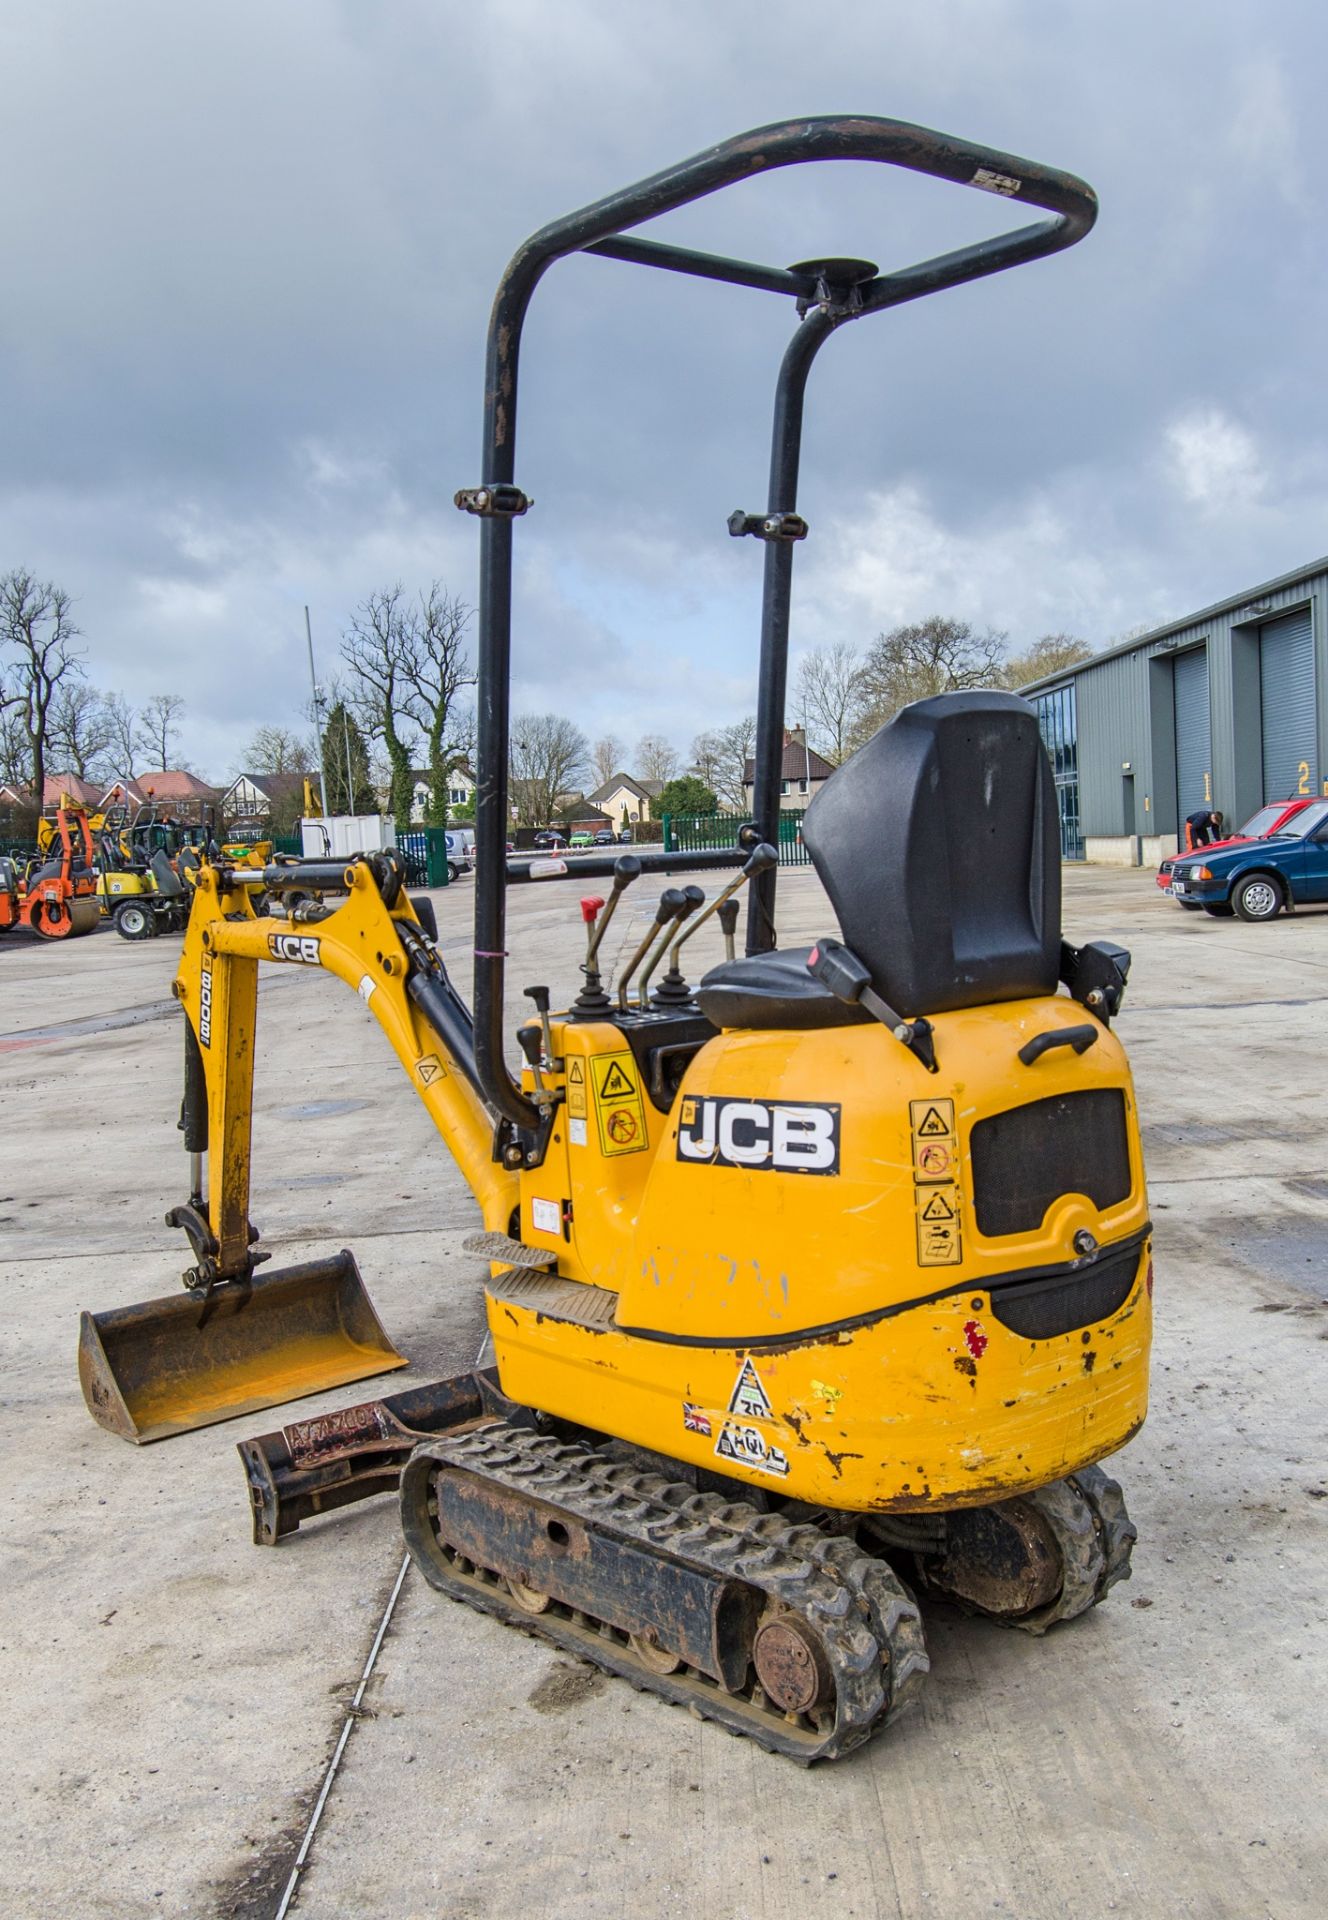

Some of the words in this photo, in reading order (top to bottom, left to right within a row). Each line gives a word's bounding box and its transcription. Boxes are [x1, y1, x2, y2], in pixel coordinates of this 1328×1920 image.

[1203, 772, 1211, 801] 1
[1298, 761, 1310, 795] 2
[269, 935, 320, 964] JCB
[201, 971, 212, 1039] 8008
[679, 1101, 836, 1168] JCB
